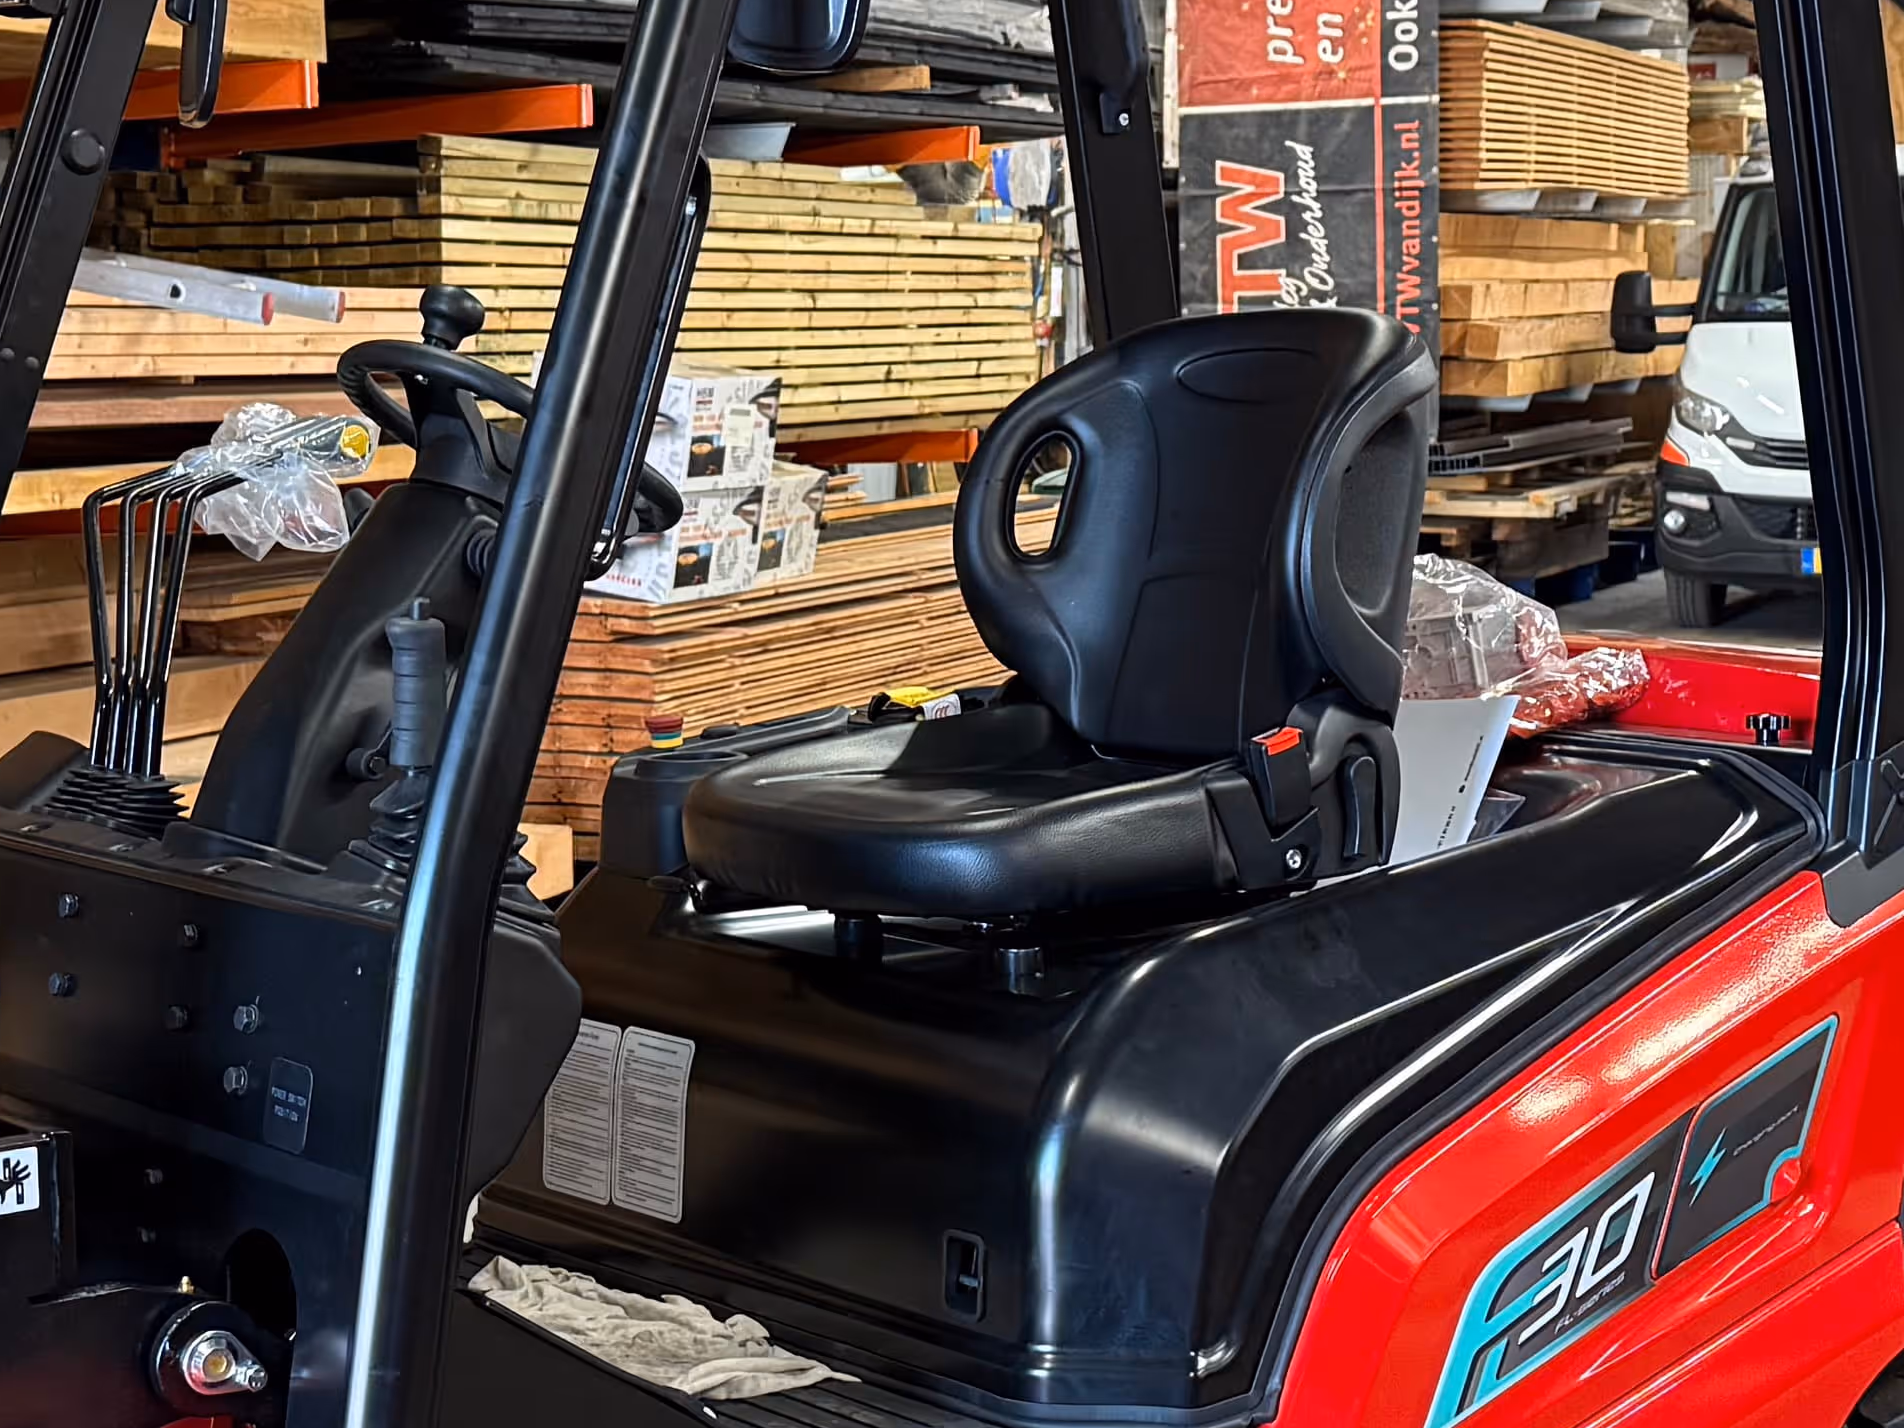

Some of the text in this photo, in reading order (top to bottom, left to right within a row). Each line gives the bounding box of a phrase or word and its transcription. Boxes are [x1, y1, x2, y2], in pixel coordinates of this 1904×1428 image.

[1315, 12, 1344, 64] en
[1214, 159, 1287, 315] TW
[1284, 139, 1335, 291] Onderhoud
